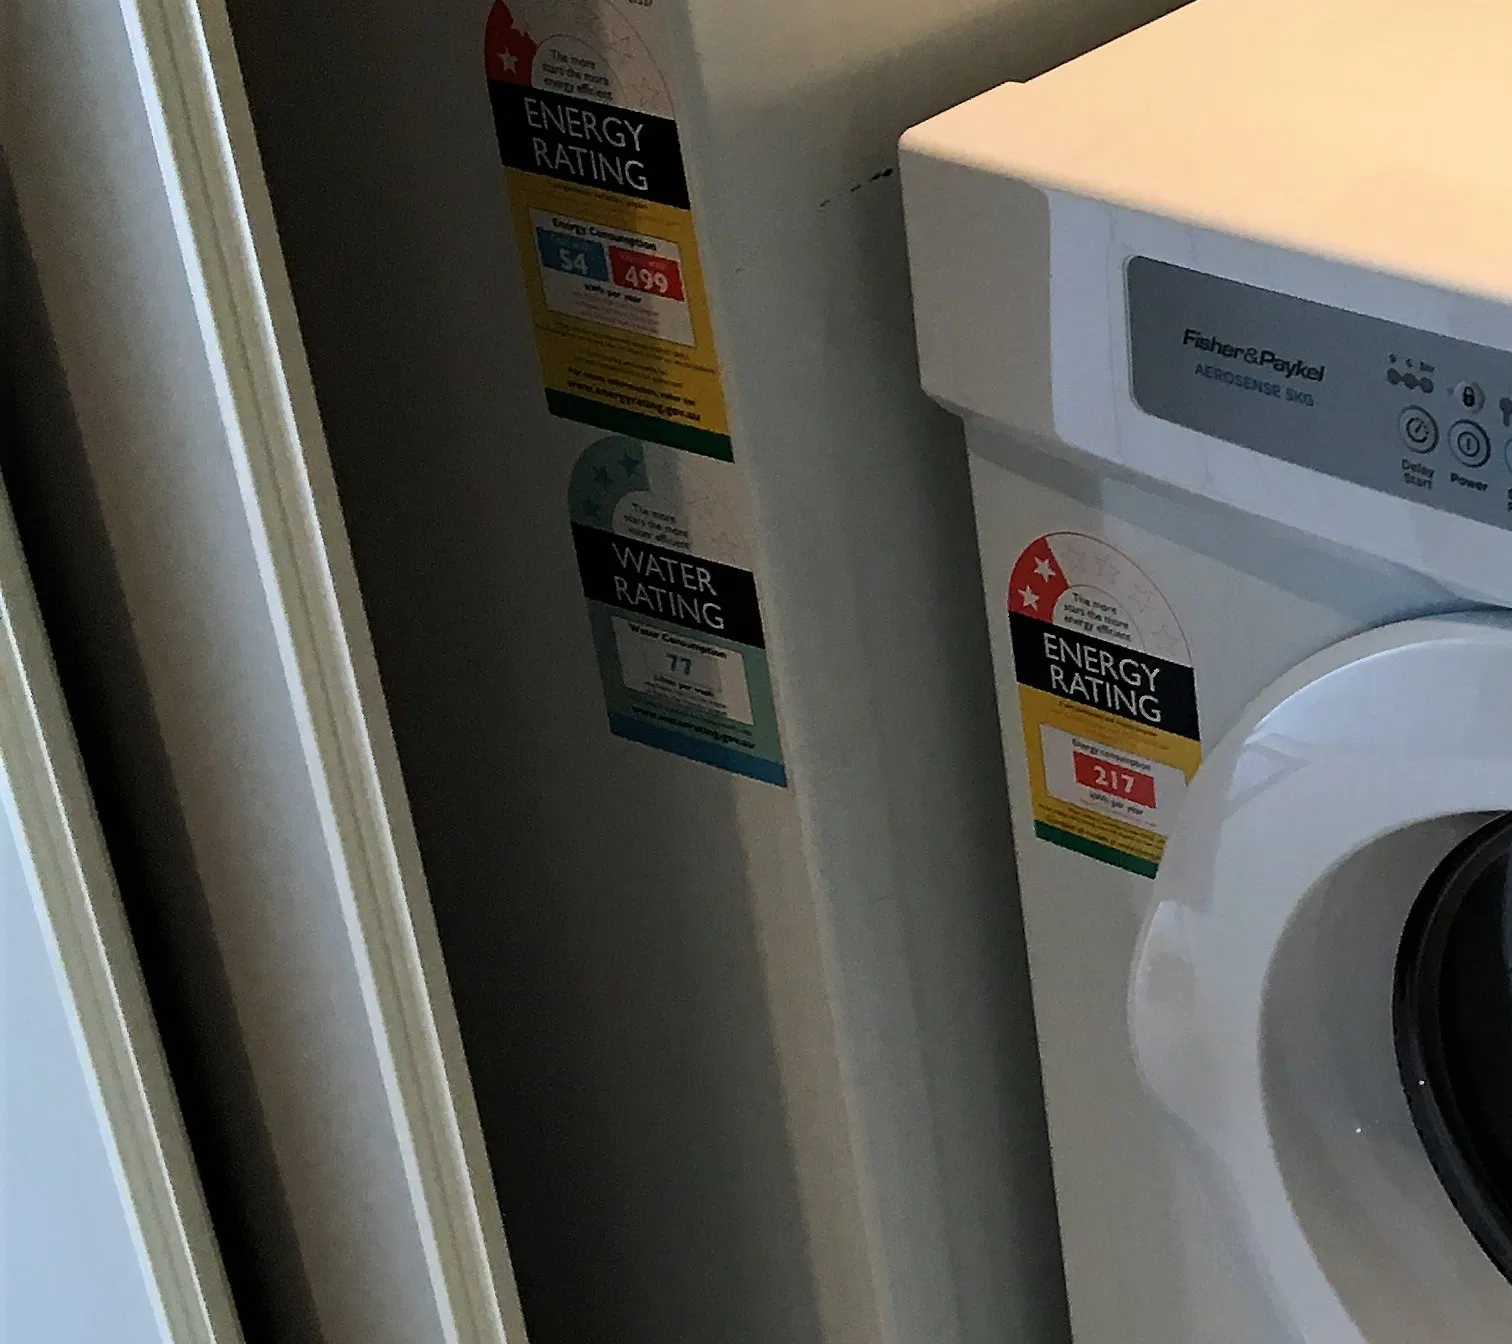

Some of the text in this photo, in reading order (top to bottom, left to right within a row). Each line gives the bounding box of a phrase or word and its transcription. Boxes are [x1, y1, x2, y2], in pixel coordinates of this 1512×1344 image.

[550, 48, 596, 70] The more
[584, 73, 609, 86] more
[523, 97, 644, 152] ENERGY
[533, 137, 649, 191] RATING
[552, 217, 586, 235] Energy
[589, 226, 657, 251] Consumption
[559, 248, 588, 275] 54
[624, 265, 669, 294] 499
[1183, 328, 1326, 382] Fisher&Paykel
[1194, 363, 1315, 407] AEROSENSE 5KG
[1402, 459, 1435, 478] Delay
[1404, 472, 1432, 490] Start
[1451, 472, 1488, 492] Power
[652, 510, 676, 523] more
[664, 525, 689, 538] more
[612, 542, 718, 596] WATER
[614, 575, 725, 630] RATING
[1072, 592, 1117, 615] The more
[1104, 616, 1129, 630] more
[628, 622, 727, 659] Water Consumption
[667, 652, 692, 675] 77
[1044, 633, 1160, 693] ENERGY
[1050, 664, 1162, 723] RATING
[1072, 738, 1099, 755] Energy
[1093, 765, 1136, 794] 217
